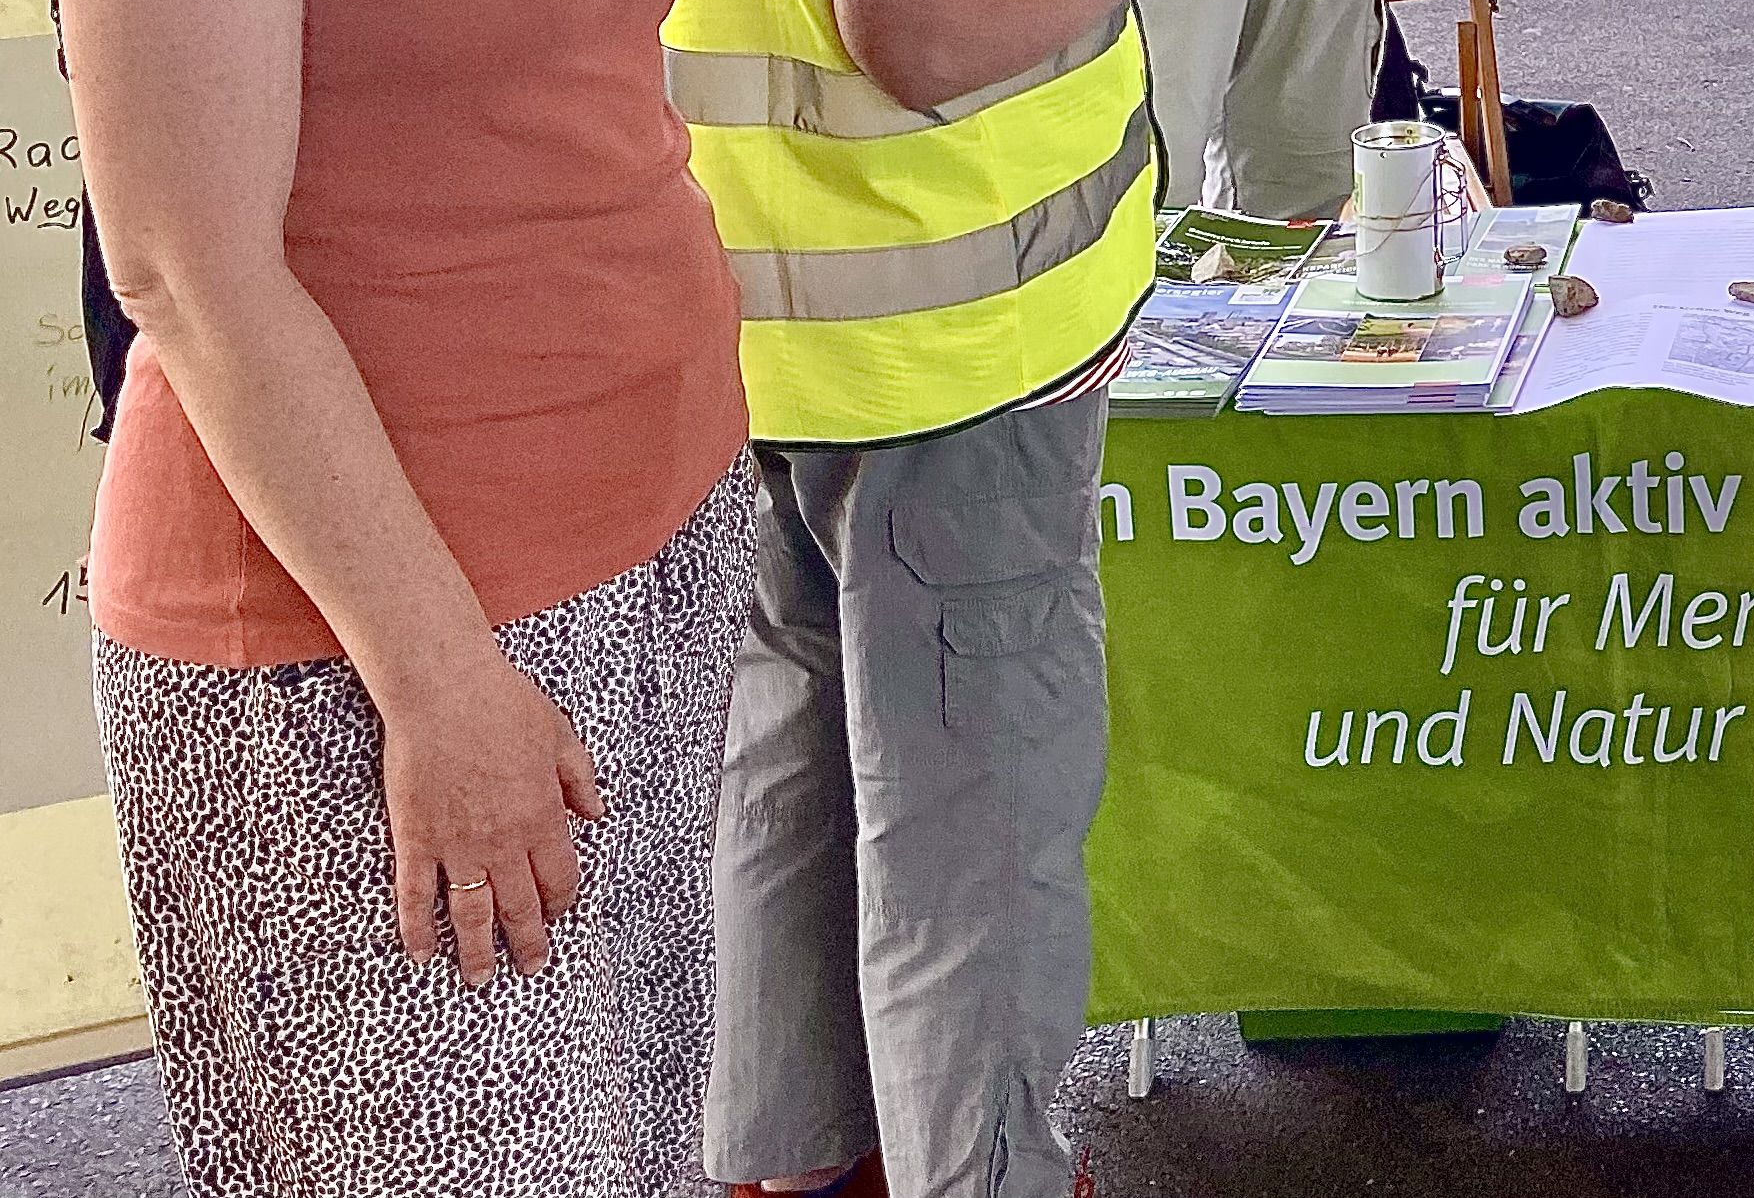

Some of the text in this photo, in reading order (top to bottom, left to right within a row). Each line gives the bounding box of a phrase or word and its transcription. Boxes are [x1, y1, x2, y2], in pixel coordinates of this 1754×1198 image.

[5, 186, 80, 230] Weg
[1165, 462, 1486, 567] Bayern
[1516, 450, 1743, 540] aktiv
[1438, 573, 1571, 676] für
[1303, 688, 1747, 769] und Natur
